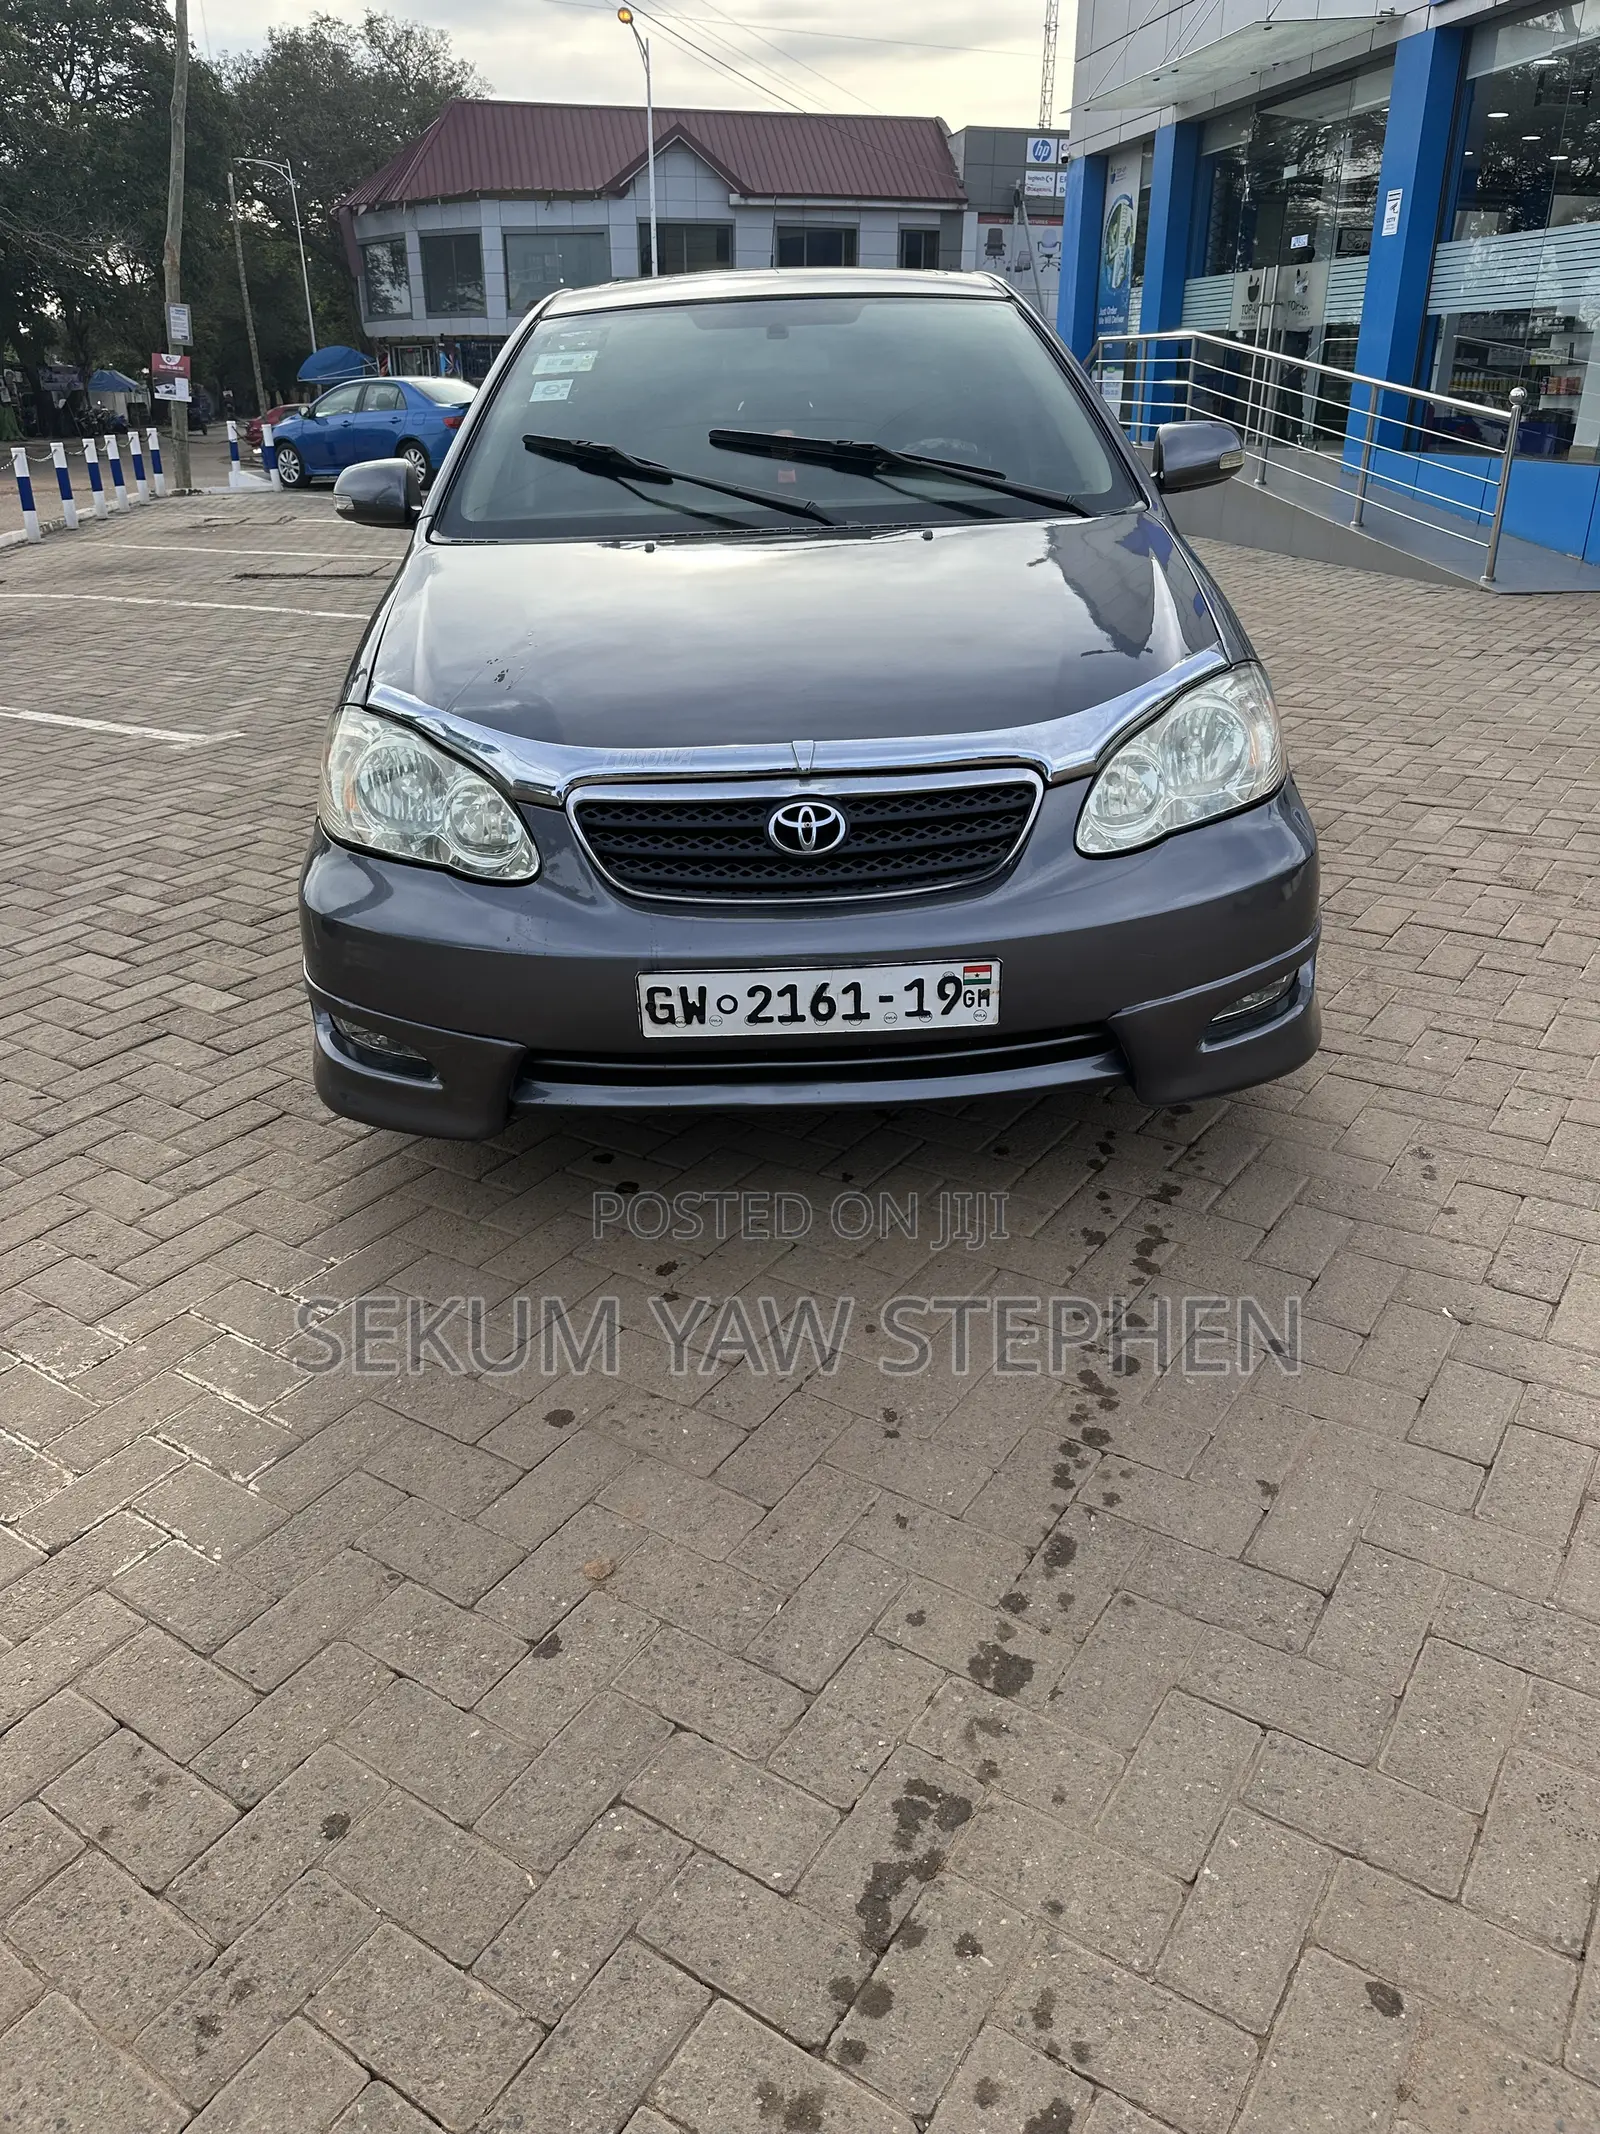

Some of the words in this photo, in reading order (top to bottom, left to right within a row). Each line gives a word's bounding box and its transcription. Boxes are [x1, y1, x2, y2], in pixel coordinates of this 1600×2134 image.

[1033, 140, 1051, 161] hp
[1241, 303, 1259, 315] TOP-U
[601, 748, 694, 768] COROLLA
[645, 985, 707, 1025] GW
[747, 976, 963, 1023] 2161-19
[963, 988, 991, 1008] GH
